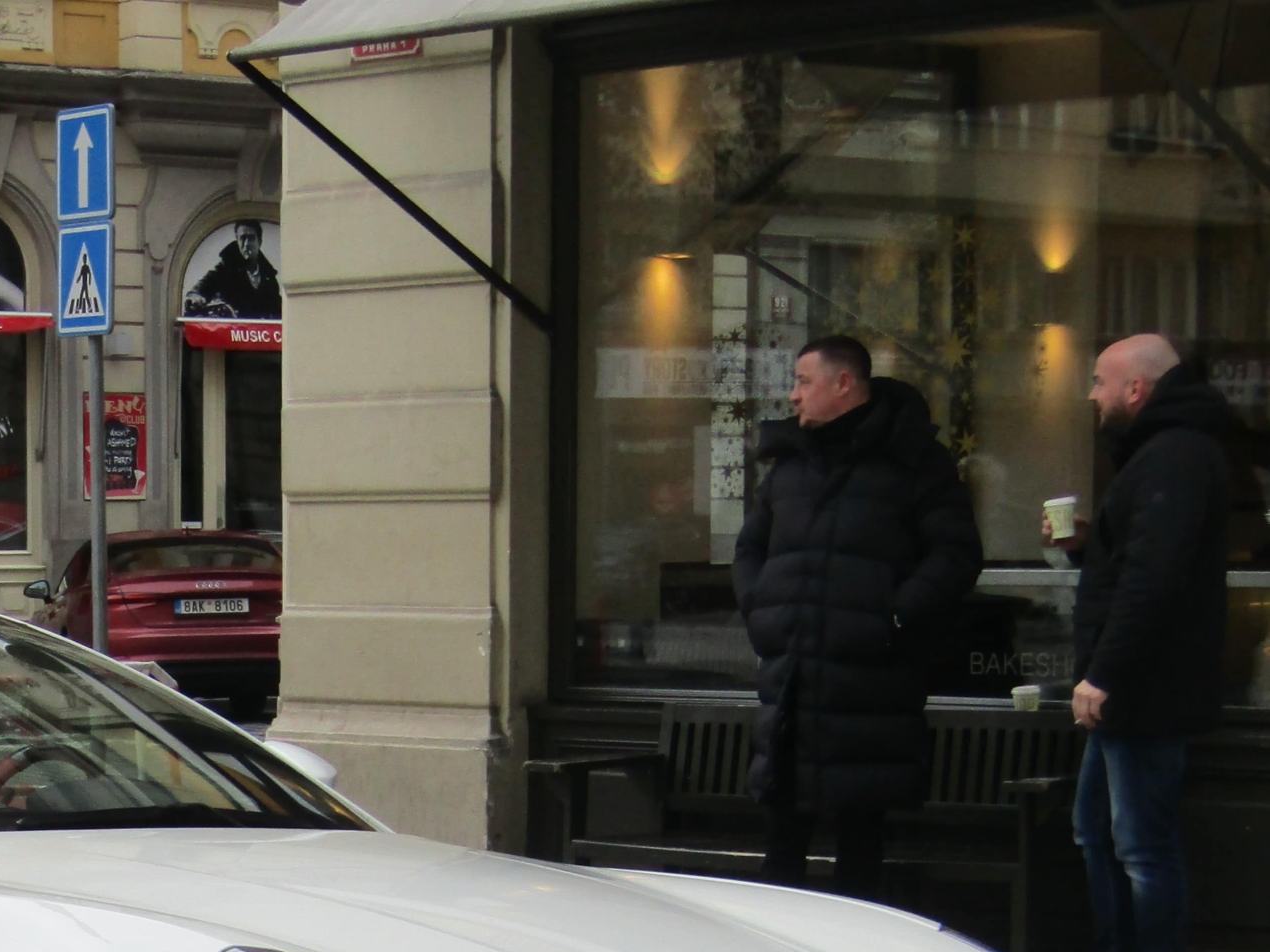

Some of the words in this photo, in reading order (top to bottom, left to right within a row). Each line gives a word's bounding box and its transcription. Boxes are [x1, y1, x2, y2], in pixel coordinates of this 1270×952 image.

[362, 41, 397, 54] PRAHA
[400, 40, 406, 48] 1
[230, 329, 271, 343] MUSIC
[184, 600, 205, 613] 8AK
[214, 599, 244, 612] 8106
[969, 651, 1073, 677] BAKESH
